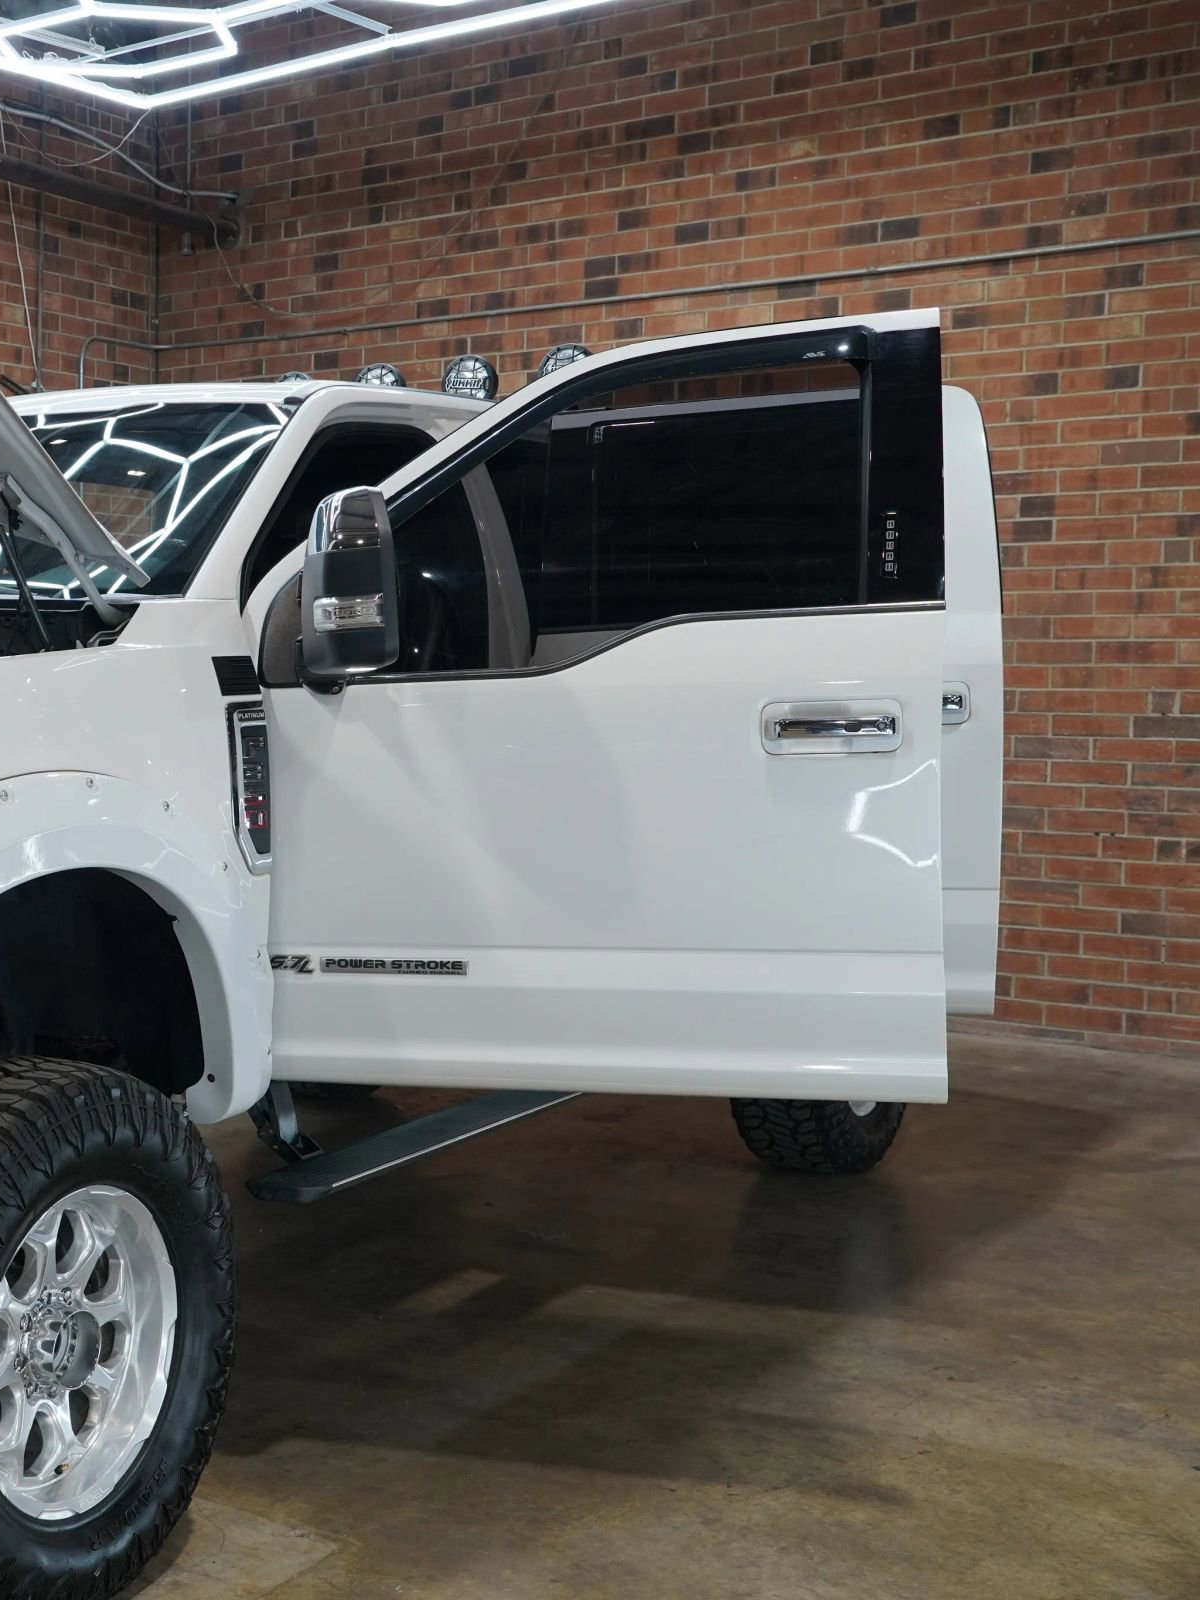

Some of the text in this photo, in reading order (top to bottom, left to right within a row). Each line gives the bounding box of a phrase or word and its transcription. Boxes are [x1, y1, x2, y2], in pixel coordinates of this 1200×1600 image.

[237, 711, 265, 719] PLATINUM
[325, 959, 463, 970] POWER STROKE
[79, 1487, 110, 1510] FUEL
